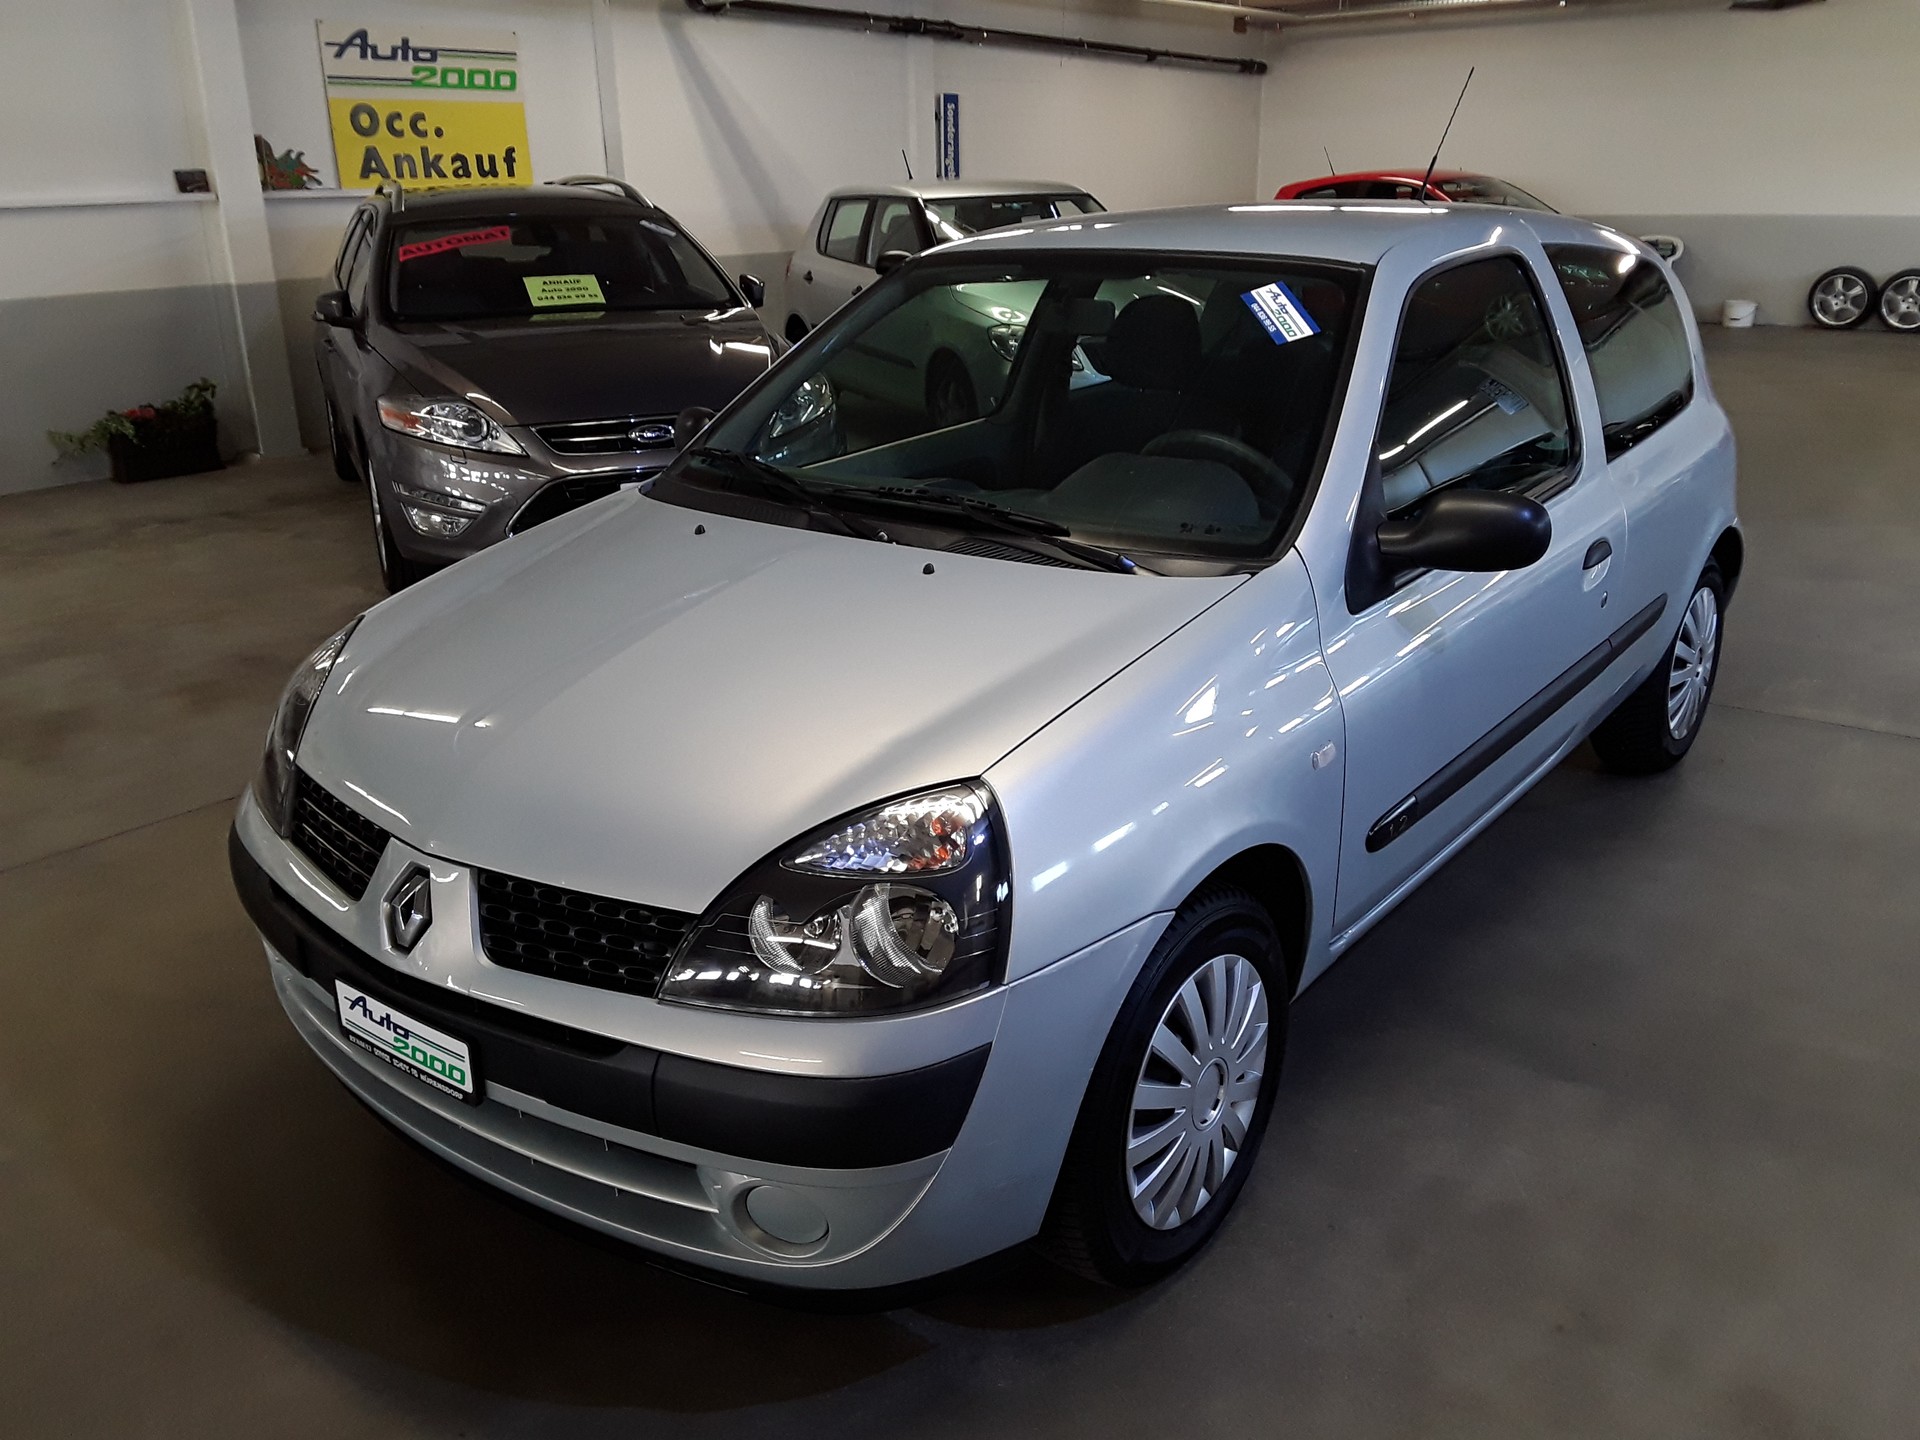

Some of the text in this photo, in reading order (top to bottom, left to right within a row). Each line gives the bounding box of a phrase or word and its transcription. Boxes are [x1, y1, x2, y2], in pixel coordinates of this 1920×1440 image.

[327, 28, 438, 62] Auto
[411, 66, 517, 91] 2000
[350, 102, 444, 138] Occ.
[359, 146, 516, 179] Ankauf
[402, 230, 507, 256] AUTOMAT
[1265, 287, 1289, 315] Auto
[1273, 308, 1298, 338] 2000
[346, 996, 410, 1041] Auto
[393, 1036, 466, 1086] 2000
